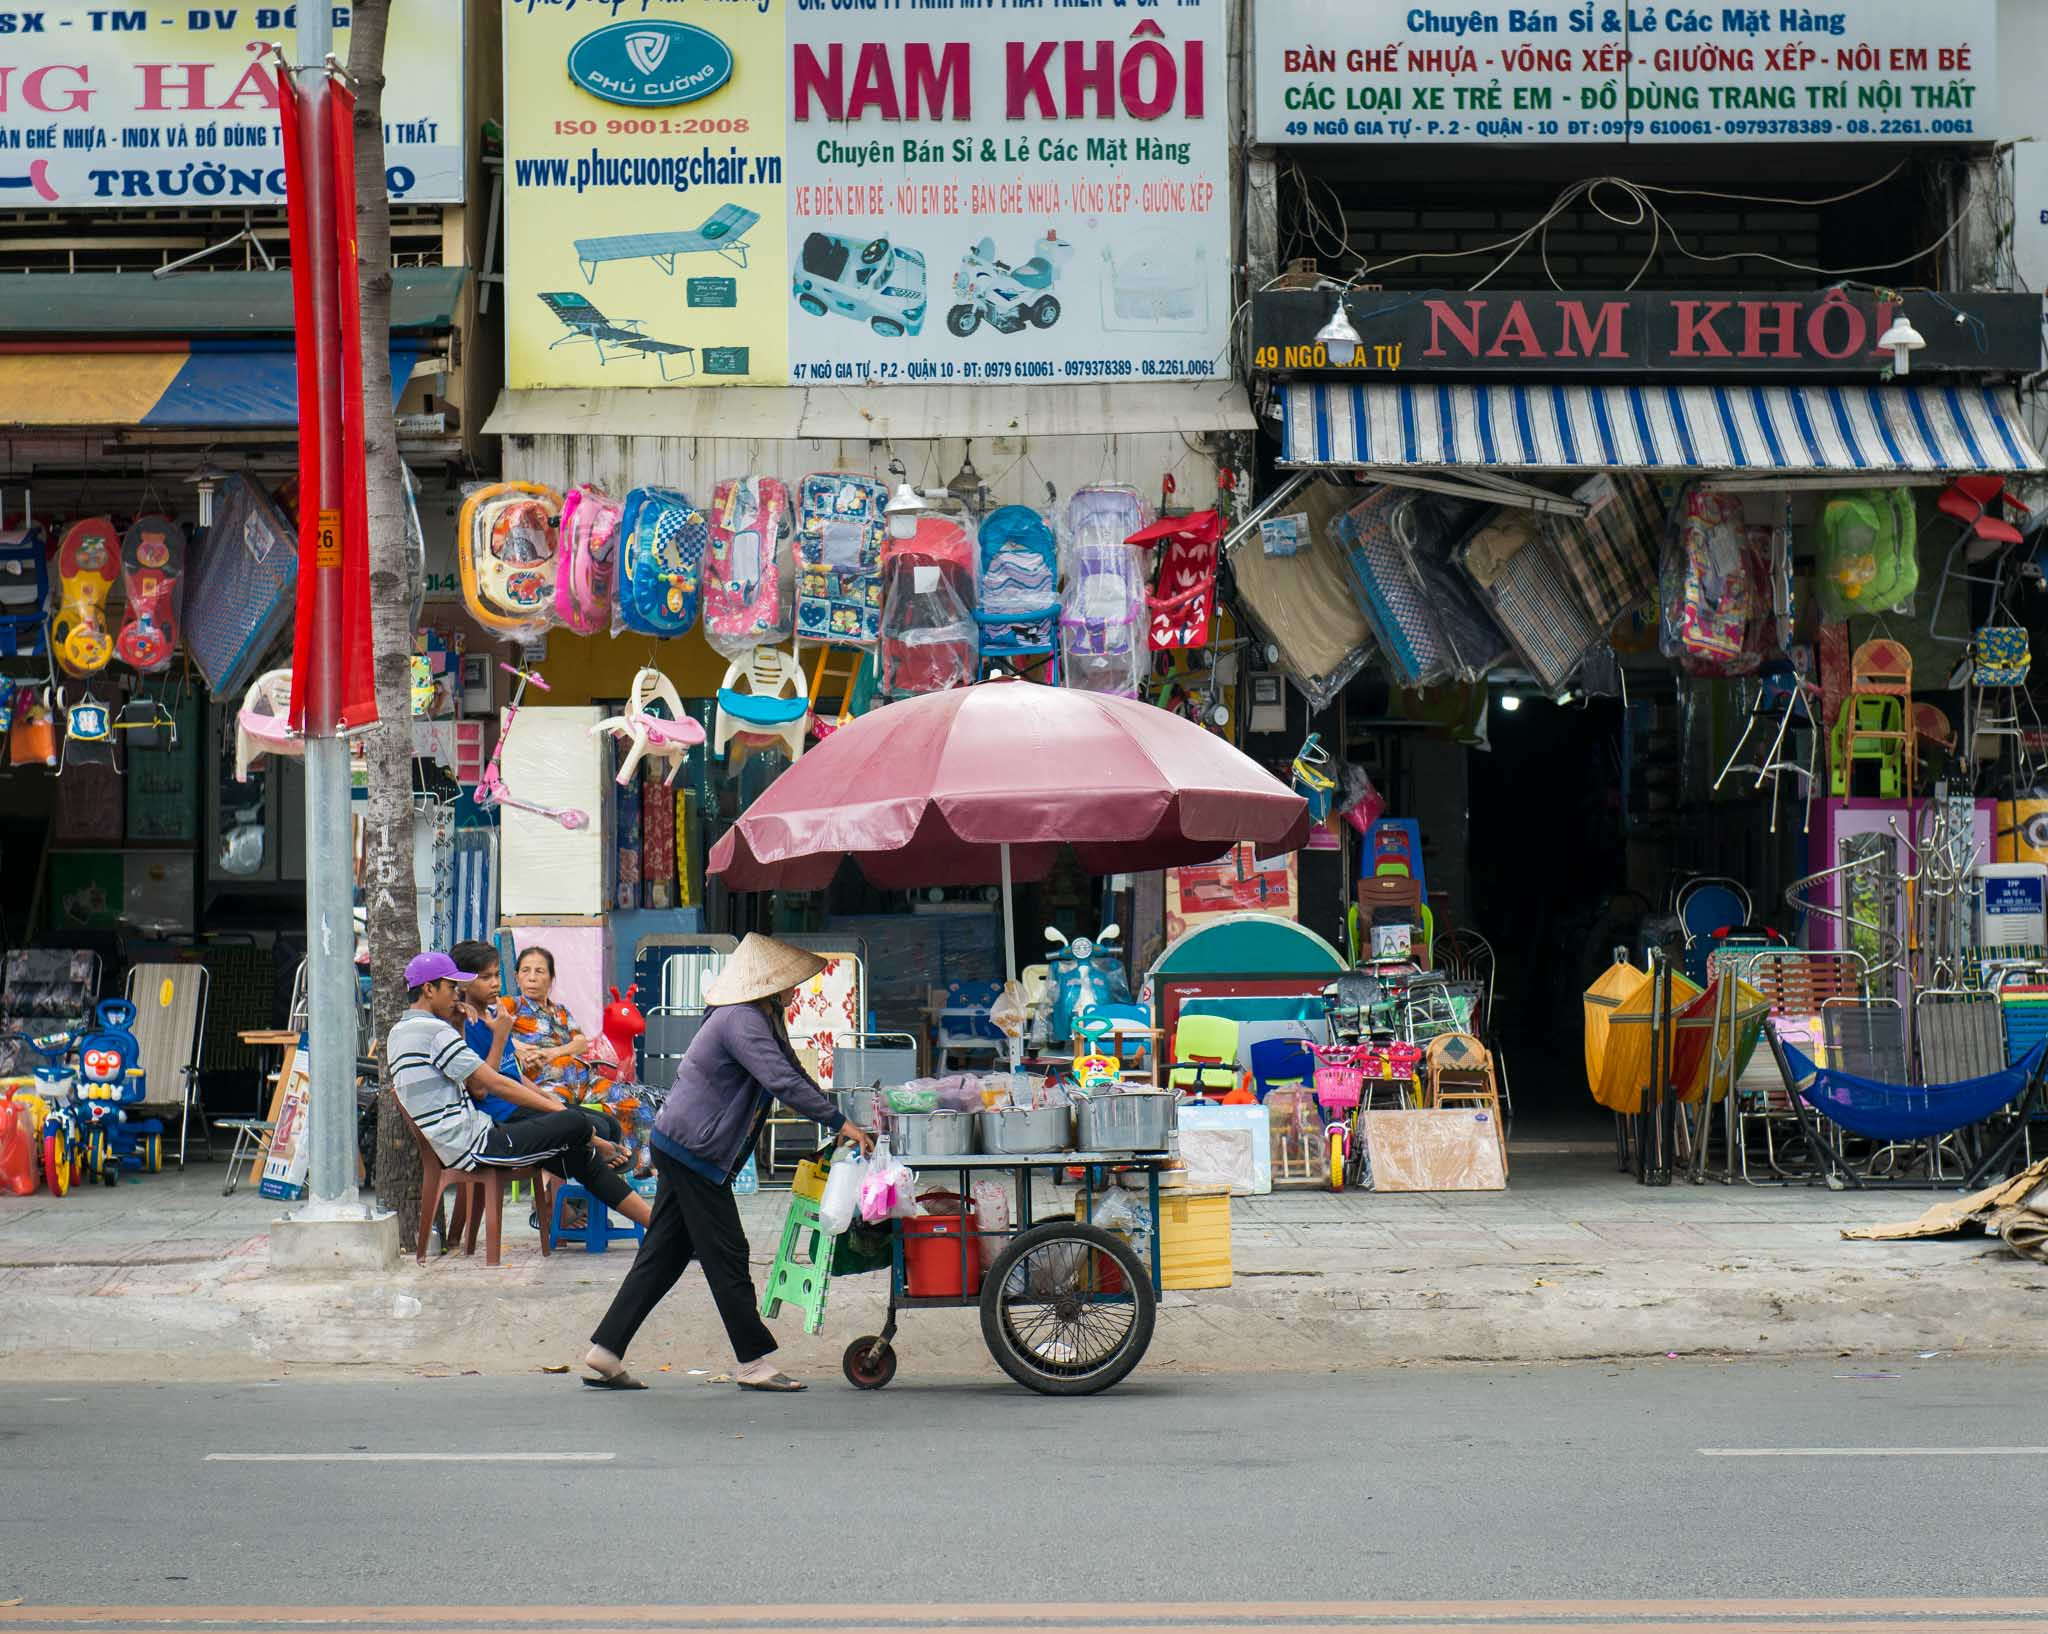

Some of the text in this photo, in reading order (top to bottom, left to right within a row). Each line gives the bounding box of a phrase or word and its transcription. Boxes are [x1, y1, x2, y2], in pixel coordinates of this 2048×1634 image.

[88, 11, 146, 31] TM
[189, 10, 237, 30] DV
[1407, 2, 1845, 37] Chuyên Bán Sỉ & Lẻ Các Mặt Hàng
[794, 19, 1204, 123] NAM KHÔI
[1285, 45, 1335, 72] BÀN
[1347, 42, 1402, 72] GHẾ
[1408, 45, 1477, 77] NHỰA
[1501, 44, 1571, 71] VÕNG
[1581, 41, 1632, 74] XẾP
[1654, 43, 1753, 72] GIƯỜNG
[1765, 41, 1816, 71] XẾP
[1838, 43, 1880, 71] NÔI
[1890, 49, 1927, 70] EM
[1939, 43, 1971, 71] BÉ
[587, 63, 715, 96] PHÚ CƯỜNG
[1285, 82, 1335, 110] CÁC
[1347, 87, 1401, 115] LOẠI
[1412, 88, 1444, 109] XE
[1453, 79, 1502, 109] TRẺ
[1514, 87, 1551, 109] EM
[1581, 79, 1616, 109] ĐỒ
[1628, 82, 1699, 110] DÙNG
[1709, 86, 1795, 109] TRANG
[1805, 81, 1846, 108] TRÍ
[1859, 80, 1901, 113] NỘI
[1911, 79, 1976, 108] THẤT
[26, 124, 56, 148] GHẾ
[64, 126, 106, 152] NHỰA
[123, 128, 159, 147] INOX
[396, 118, 437, 143] THẤT
[556, 119, 749, 135] ISO 9001:2008
[1286, 122, 1307, 135] 49
[1314, 118, 1348, 135] NGÔ
[1355, 121, 1383, 135] GIA
[1388, 119, 1412, 138] TỰ
[1476, 118, 1522, 138] QUẬN
[1538, 121, 1558, 134] 10
[1602, 119, 1644, 136] 0979
[1650, 121, 1712, 134] 610061
[1725, 120, 1832, 134] 0979378389
[817, 136, 1190, 167] Chuyên Bán Sỉ & Lẻ Các Mặt Hàng
[516, 147, 781, 193] www.phucuongchair.vn
[795, 185, 810, 216] XE
[847, 184, 865, 215] EM
[921, 184, 939, 214] EM
[1423, 300, 1629, 357] NAM
[794, 364, 806, 378] 47
[811, 360, 831, 378] NGÔ
[836, 363, 852, 378] GIA
[856, 360, 871, 381] TỰ
[881, 363, 897, 377] P.2
[908, 359, 936, 380] QUẬN
[941, 363, 953, 377] 10
[964, 362, 981, 377] ĐT:
[985, 362, 1011, 377] 0979
[1015, 361, 1054, 376] 610061
[1065, 360, 1131, 375] 0979378389
[1142, 360, 1214, 375] 08.2261.0061
[1255, 347, 1278, 368] 49
[1284, 340, 1326, 368] NGÔ
[1373, 342, 1402, 371] TỰ
